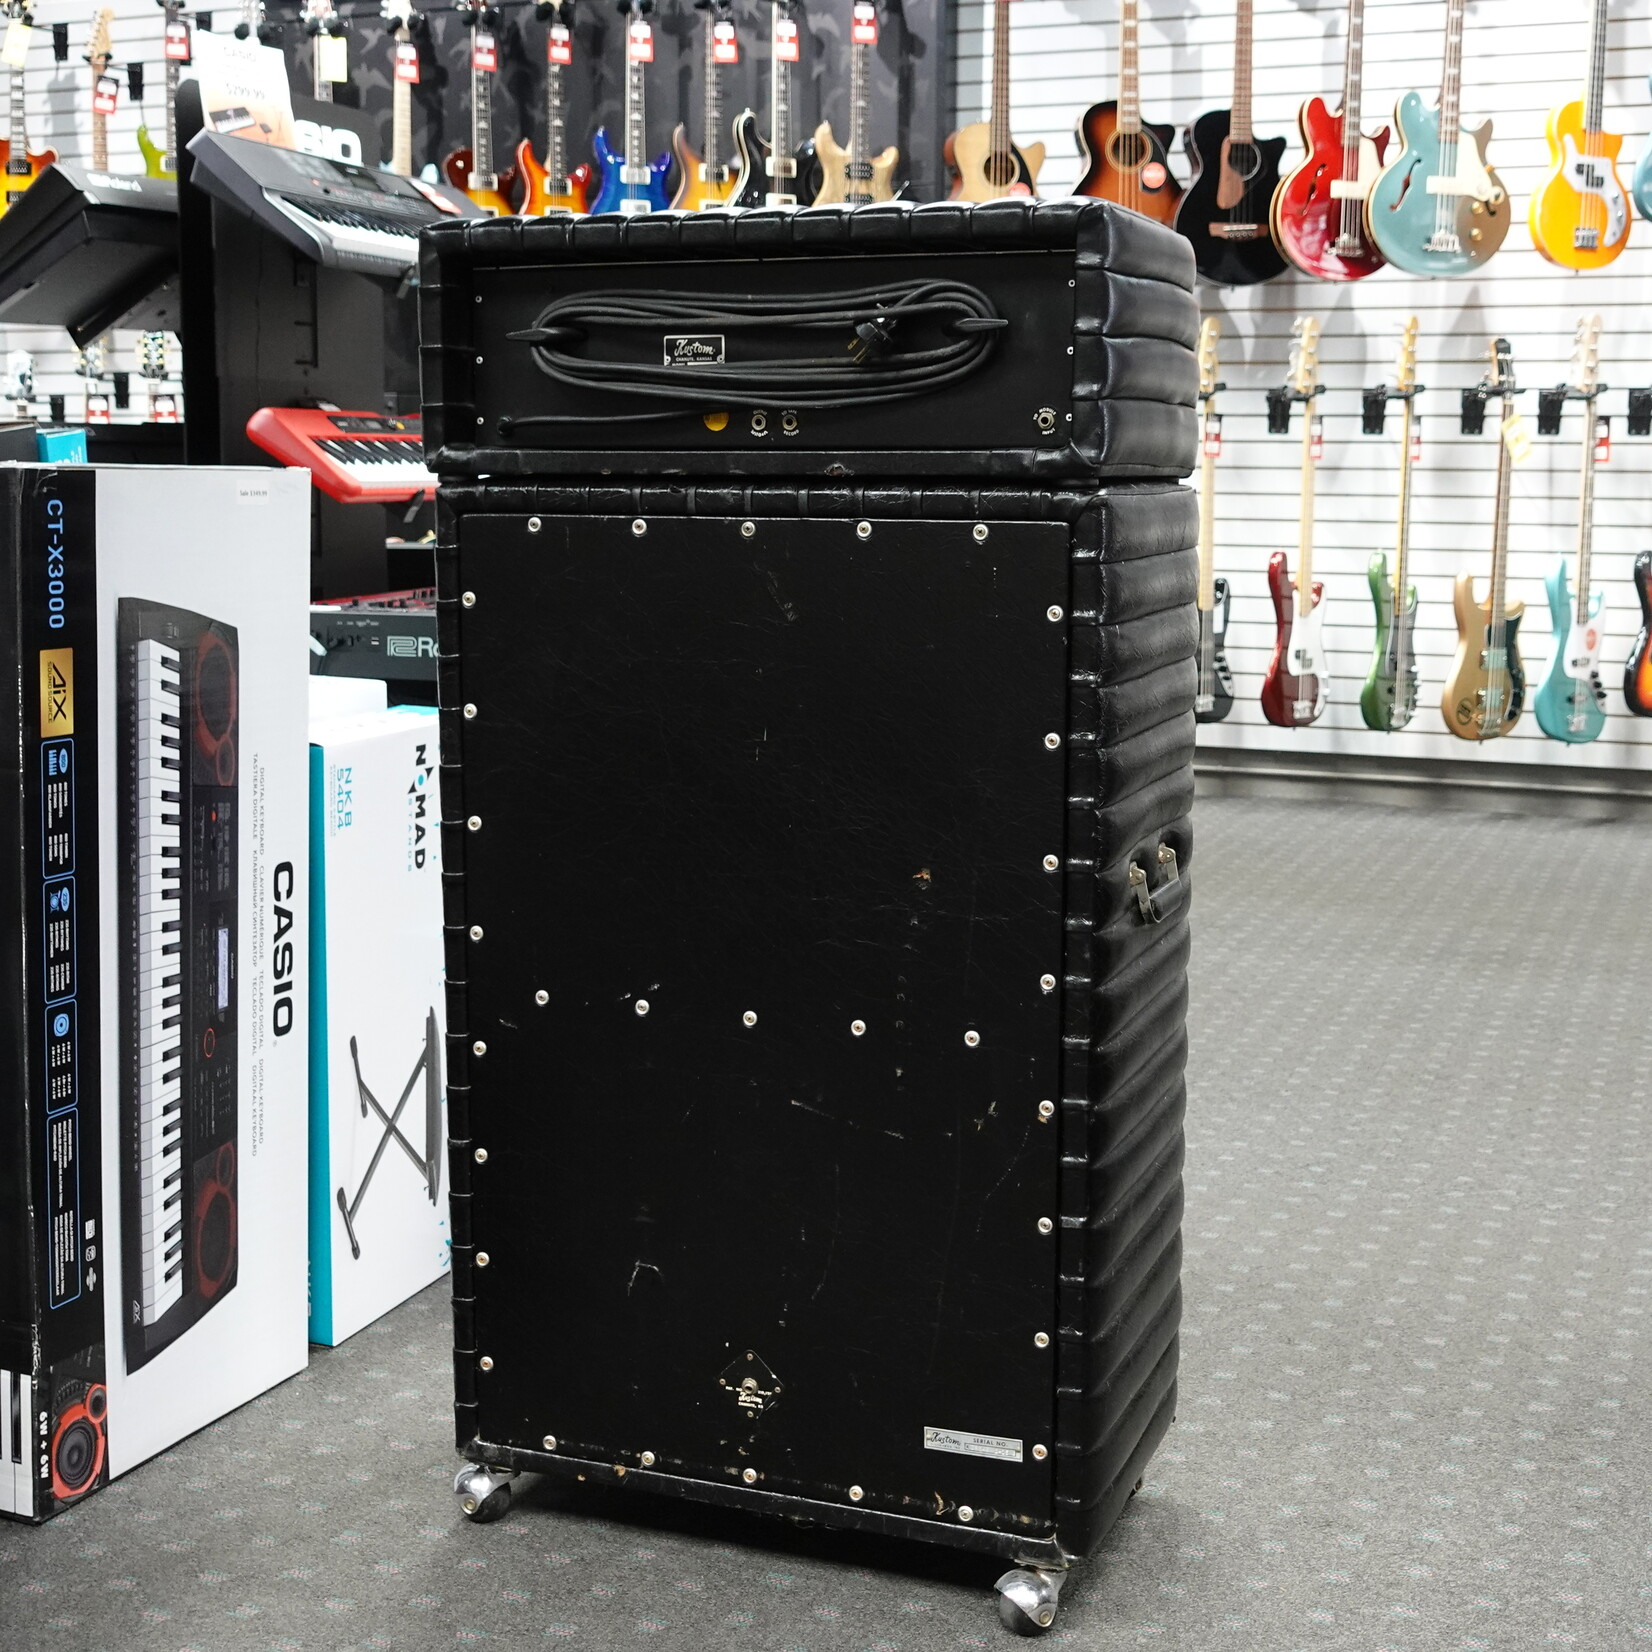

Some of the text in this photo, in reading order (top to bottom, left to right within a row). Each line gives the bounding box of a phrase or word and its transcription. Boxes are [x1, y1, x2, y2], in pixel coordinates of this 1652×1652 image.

[674, 339, 714, 356] Kustom
[1039, 407, 1057, 415] MODULE
[47, 499, 65, 629] CT-X3000
[411, 743, 430, 870] NOMAD
[274, 861, 294, 1037] CASIO
[40, 1411, 49, 1478] 6W + 6W
[930, 1431, 962, 1446] Kustom
[973, 1438, 993, 1446] SERIAL
